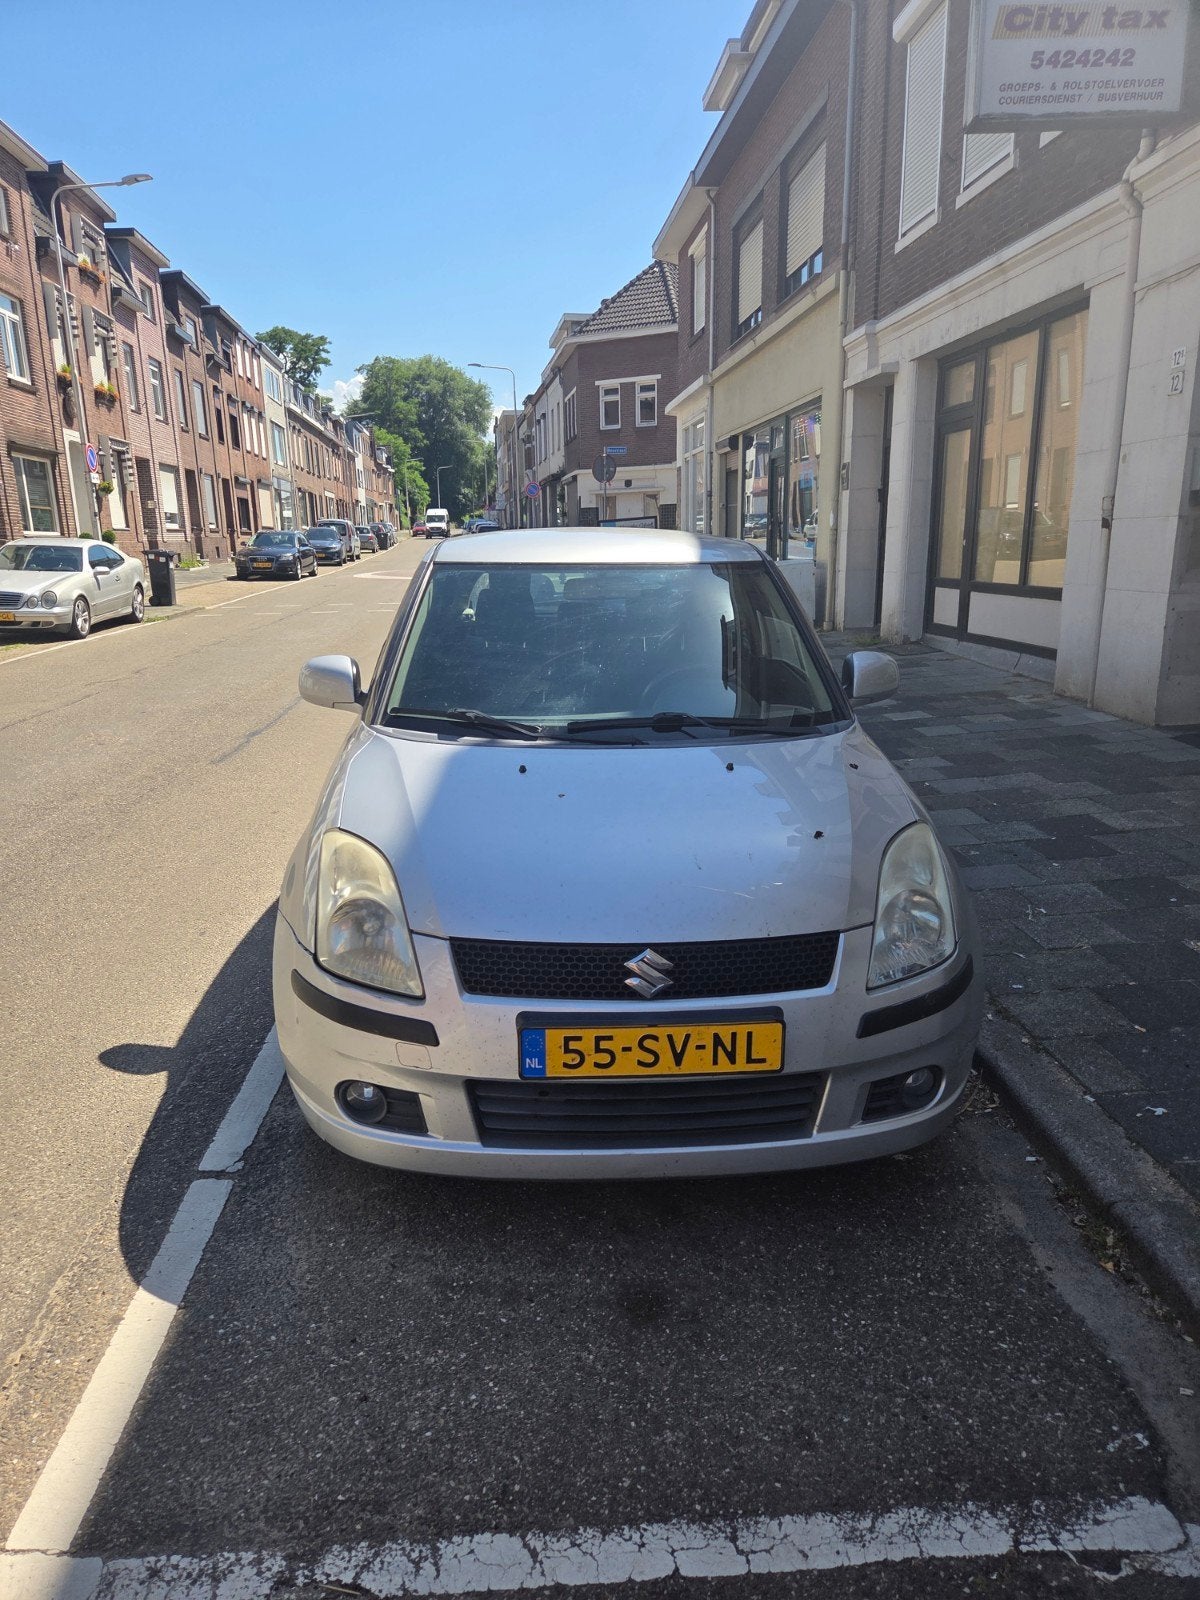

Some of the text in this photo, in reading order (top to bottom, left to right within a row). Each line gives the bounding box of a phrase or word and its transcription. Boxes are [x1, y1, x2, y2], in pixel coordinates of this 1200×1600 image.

[1003, 6, 1171, 34] City tax
[1030, 48, 1136, 70] 5424242
[999, 78, 1165, 93] GROEPS- & ROLSTOELVERVOER
[998, 93, 1082, 106] COURIERSDIENST
[1097, 91, 1164, 102] BUSVERHUUR
[1171, 374, 1180, 392] 12
[562, 1030, 767, 1070] 55-SV-NL
[525, 1057, 543, 1069] NL
